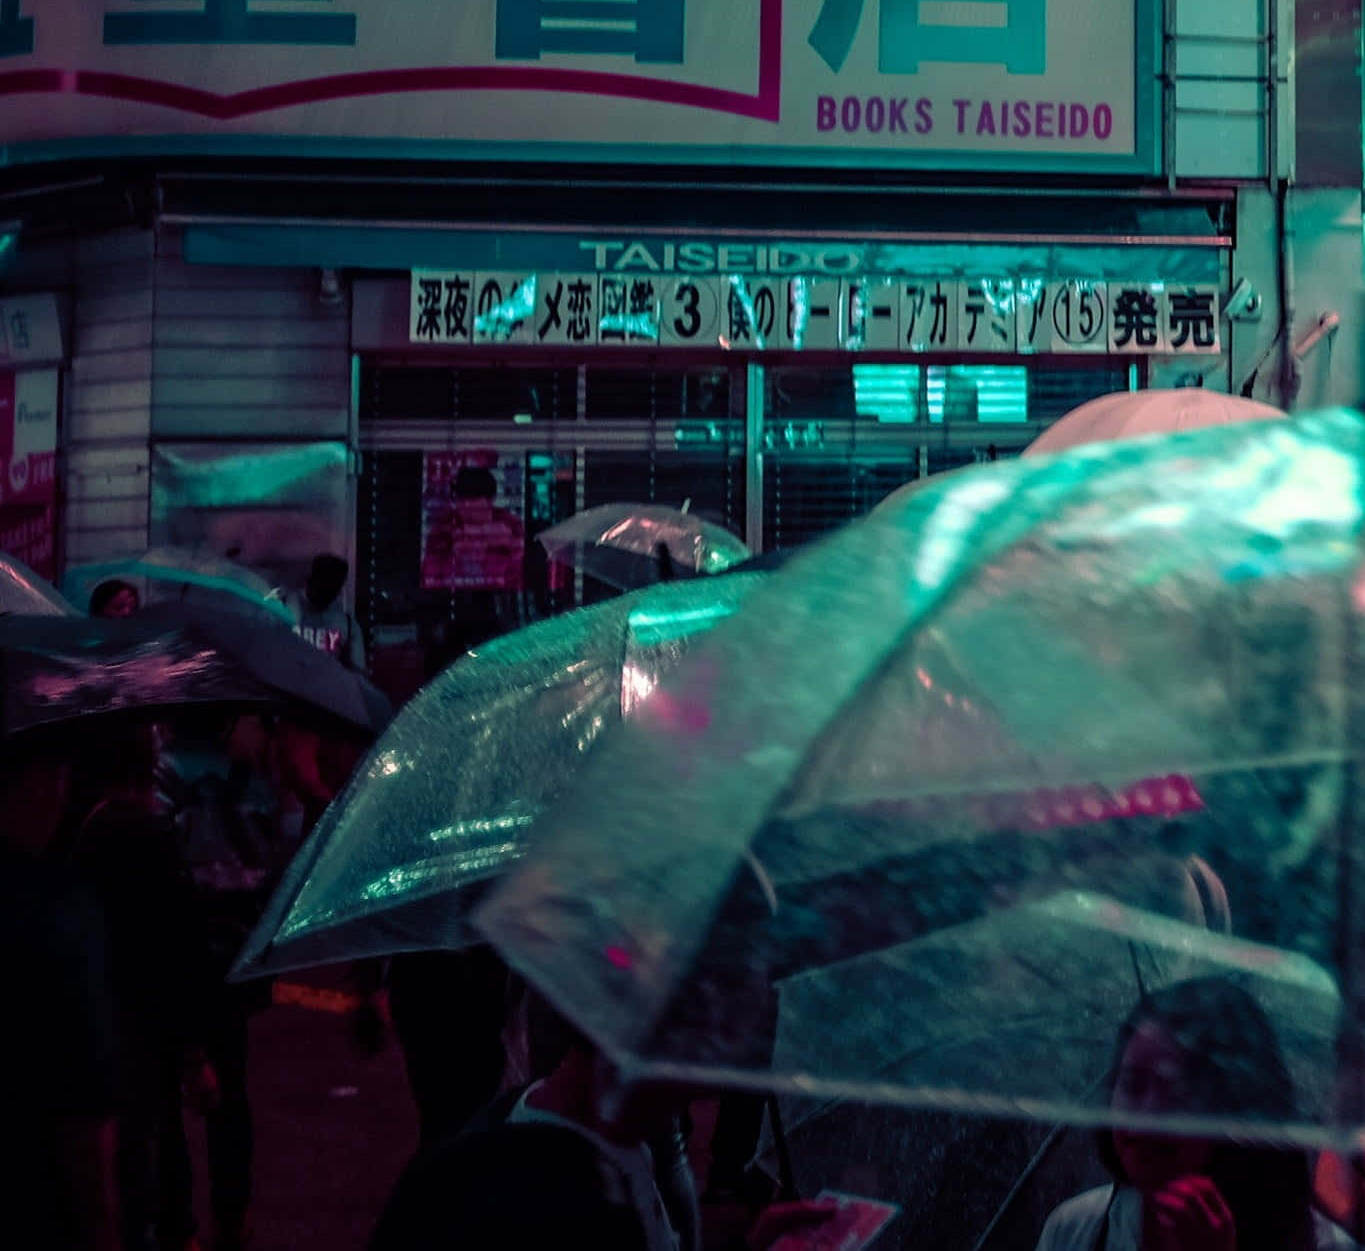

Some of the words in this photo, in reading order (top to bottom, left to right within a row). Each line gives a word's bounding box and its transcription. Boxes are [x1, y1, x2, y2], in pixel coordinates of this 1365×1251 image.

[816, 96, 934, 136] BOOKS
[951, 99, 1113, 140] TAISEIDO
[579, 241, 860, 275] TAISEIDO
